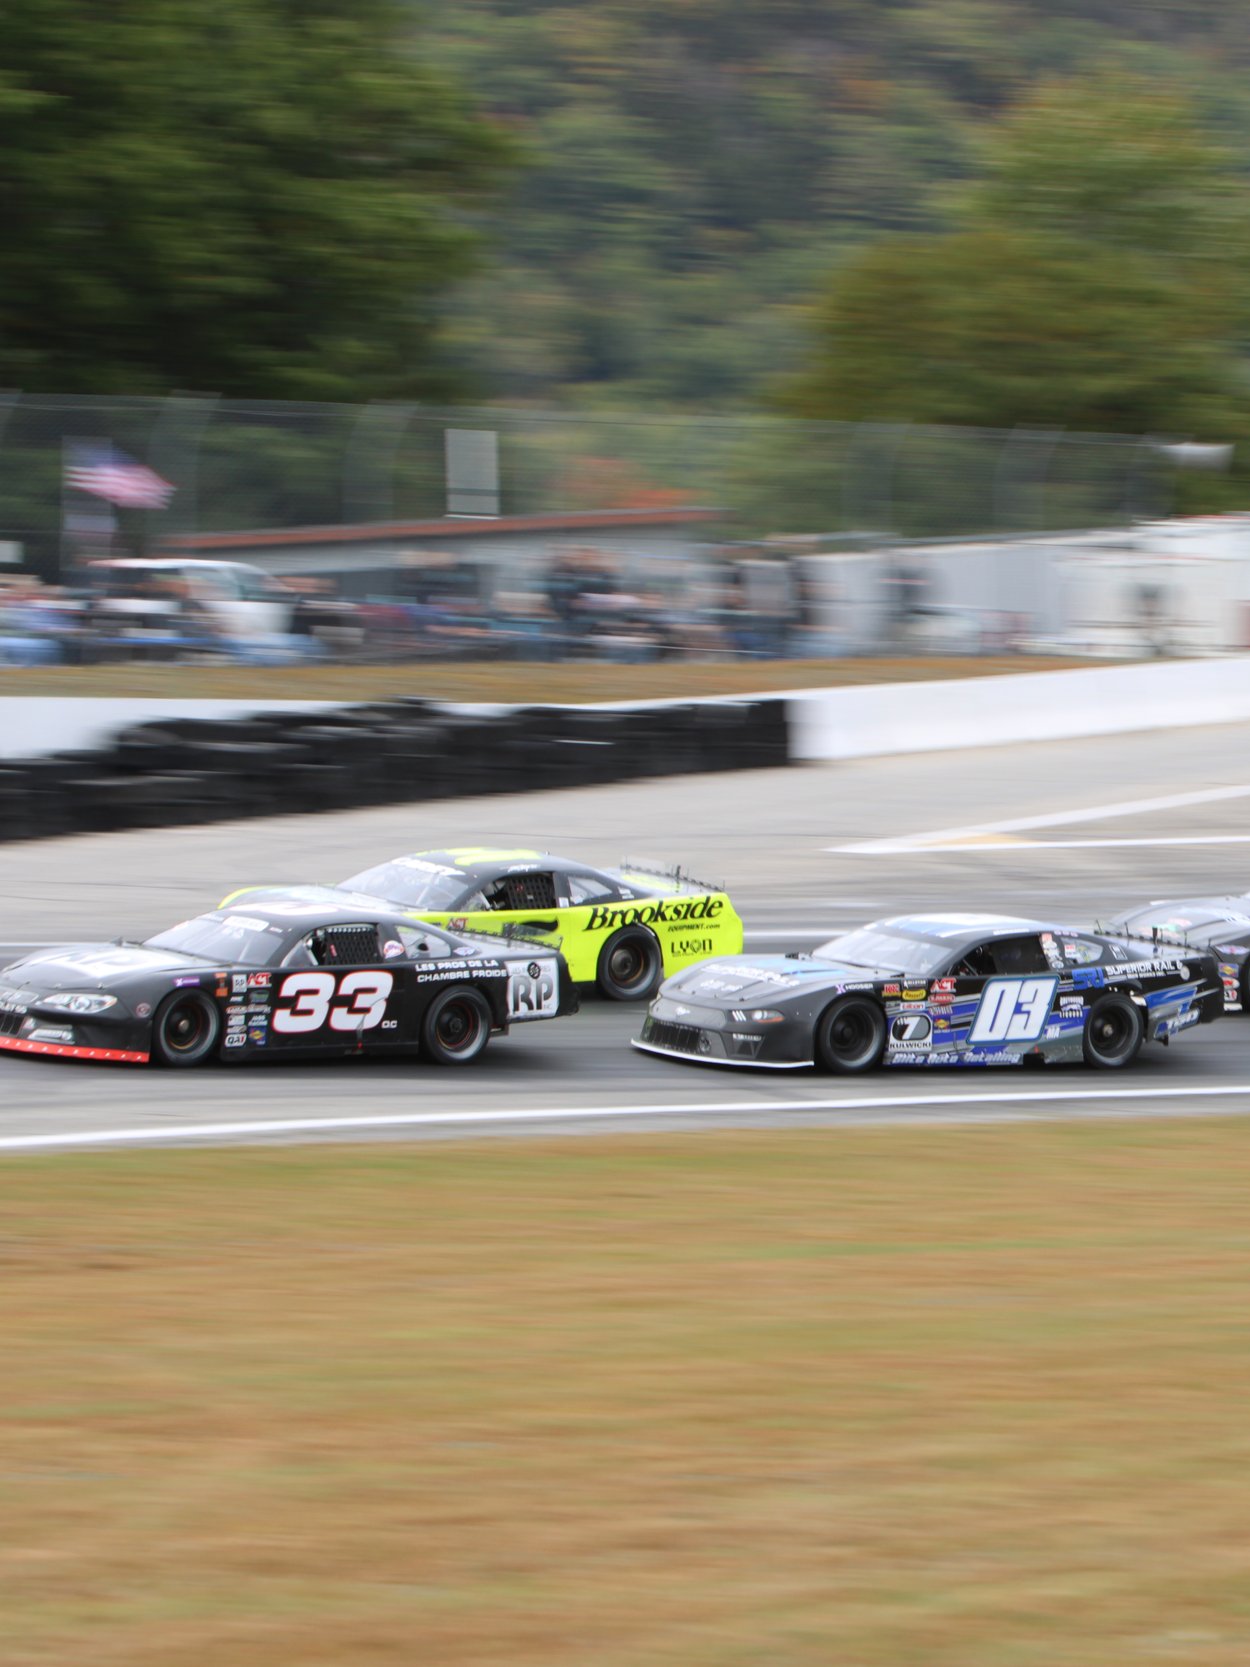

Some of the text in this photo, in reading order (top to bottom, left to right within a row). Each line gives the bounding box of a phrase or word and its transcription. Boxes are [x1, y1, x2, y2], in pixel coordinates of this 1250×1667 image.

[582, 896, 723, 931] Brookside
[415, 959, 499, 972] LES PROS DE LA
[417, 969, 470, 983] CHAMBRE
[472, 968, 508, 979] FROIDE
[1106, 963, 1152, 976] SUPERIOR
[1153, 961, 1175, 973] RAIL
[272, 970, 395, 1034] 33
[512, 976, 553, 1013] RP
[967, 977, 1059, 1043] 03
[899, 1016, 920, 1040] 7
